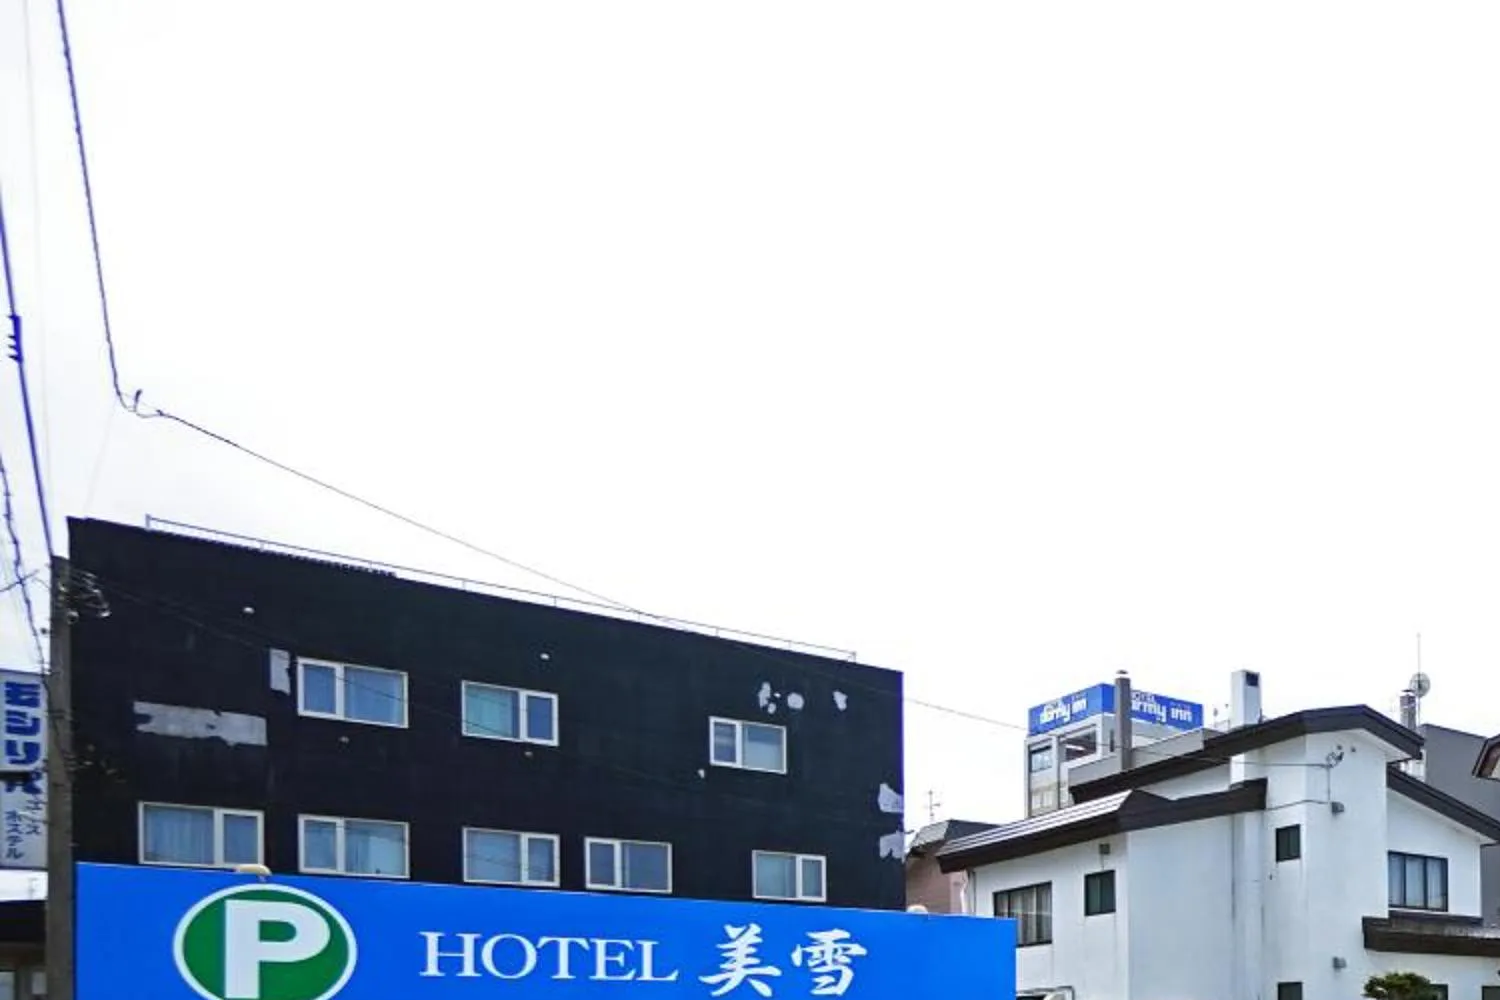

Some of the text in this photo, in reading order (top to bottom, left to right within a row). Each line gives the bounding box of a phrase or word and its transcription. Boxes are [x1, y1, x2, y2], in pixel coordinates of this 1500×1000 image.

[224, 899, 331, 1000] P
[418, 922, 868, 998] HOTEL 美雪
